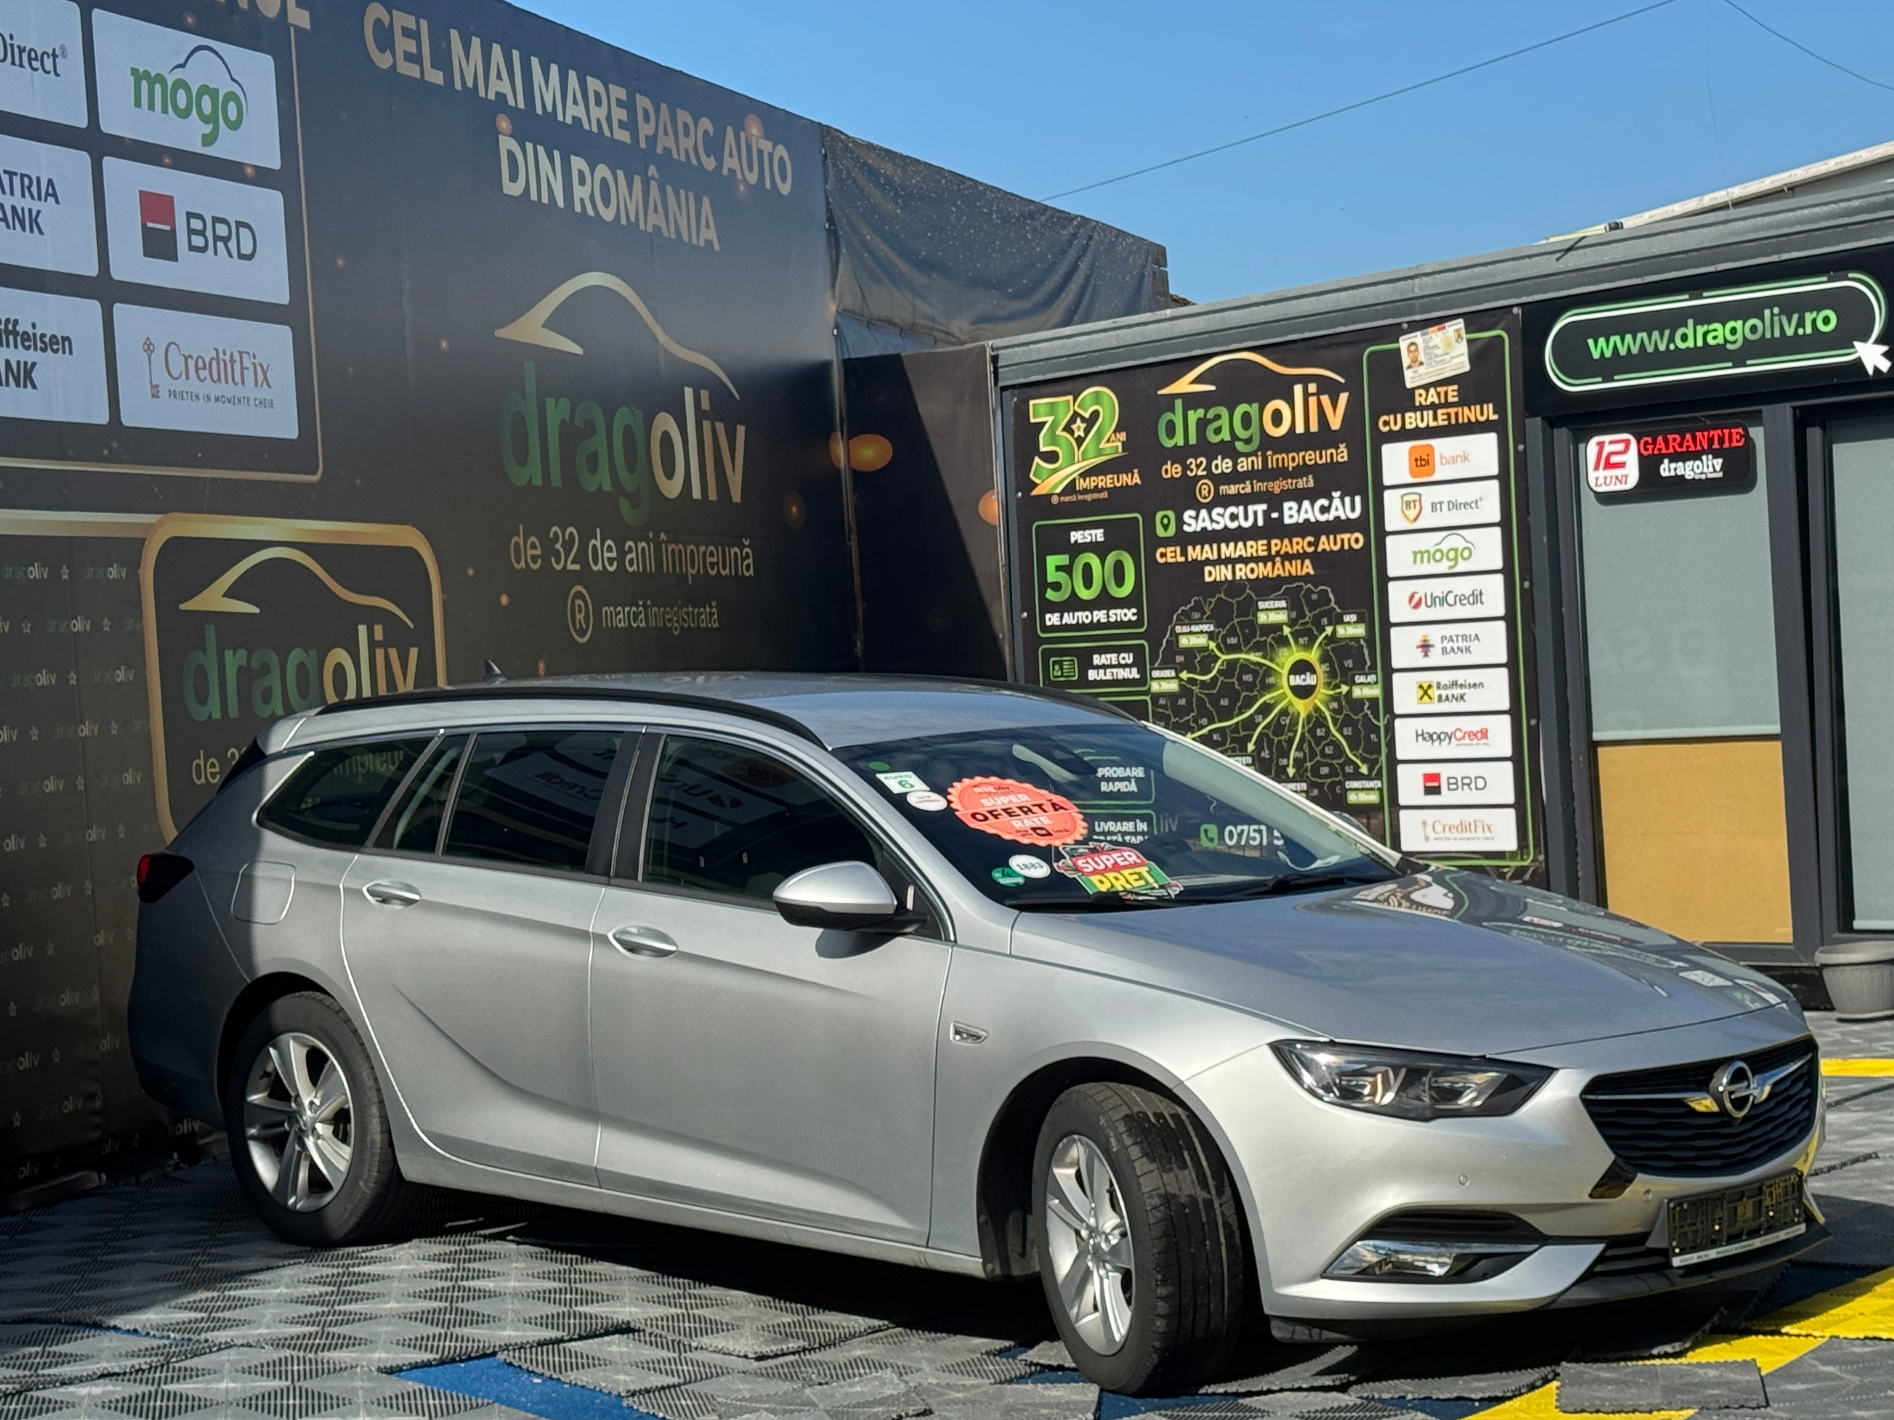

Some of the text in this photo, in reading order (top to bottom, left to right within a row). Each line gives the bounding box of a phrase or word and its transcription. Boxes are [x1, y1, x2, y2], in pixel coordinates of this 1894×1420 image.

[130, 66, 245, 148] mogo
[363, 2, 793, 197] CEL MAI MARE PARC AUTO
[498, 134, 720, 253] DIN ROMÂNIA
[185, 211, 258, 262] BRD
[1587, 306, 1838, 360] www.dragoliv.ro
[0, 358, 38, 391] NK
[164, 341, 272, 389] CreditFix
[1414, 385, 1460, 406] RATE
[1158, 383, 1350, 454] dragoliv
[1378, 403, 1499, 433] CU BULETINUL
[500, 362, 746, 527] dragoliv
[1029, 386, 1122, 485] 32
[1593, 426, 1745, 471] 12 GARANTIE
[1161, 443, 1349, 479] de 32 de ani împreună
[1413, 451, 1470, 469] tbi bank
[1660, 454, 1724, 480] dragoliv
[1075, 468, 1142, 491] ÎMPREUNĂ
[1219, 480, 1252, 496] marcă
[1253, 476, 1314, 495] înregistrată
[1595, 474, 1629, 488] LUNI
[1182, 503, 1267, 533] SASCUT
[1283, 490, 1362, 525] BACĂU
[1430, 501, 1444, 513] BT
[1070, 528, 1105, 544] PESTE
[510, 525, 755, 584] de 32 de ani împreună
[1155, 531, 1364, 564] CEL MAI MARE PARC AUTO
[1412, 545, 1473, 570] mogo
[1045, 550, 1136, 602] 500
[1204, 556, 1314, 583] DIN ROMÂNIA
[1424, 589, 1484, 609] UniCredit
[602, 600, 645, 632] marcă
[647, 600, 720, 637] înregistrată
[1045, 607, 1138, 627] DE AUTO PE STOC
[1441, 633, 1481, 645] PATRIA
[1441, 644, 1472, 656] BANK
[1093, 652, 1133, 666] RATE CU
[1088, 665, 1141, 681] BULETINUL
[1289, 672, 1317, 686] BACĂU
[1436, 680, 1485, 692] Raiffeisen
[1437, 693, 1466, 704] BANK
[1415, 727, 1490, 747] HappyCredit
[192, 749, 220, 785] de
[1096, 766, 1146, 778] PROBARE
[896, 778, 916, 790] 6
[1100, 779, 1138, 793] RAPIDĂ
[1447, 776, 1488, 792] BRD
[970, 799, 1068, 822] OFERTĂ
[979, 794, 1032, 808] SUPER
[1009, 816, 1053, 829] RATE
[1094, 821, 1136, 833] LIVRARE
[1432, 820, 1493, 836] CreditFix
[1223, 825, 1268, 847] 0751
[1015, 861, 1045, 872] 1883
[1076, 850, 1142, 873] SUPER
[1088, 866, 1159, 893] PREȚ
